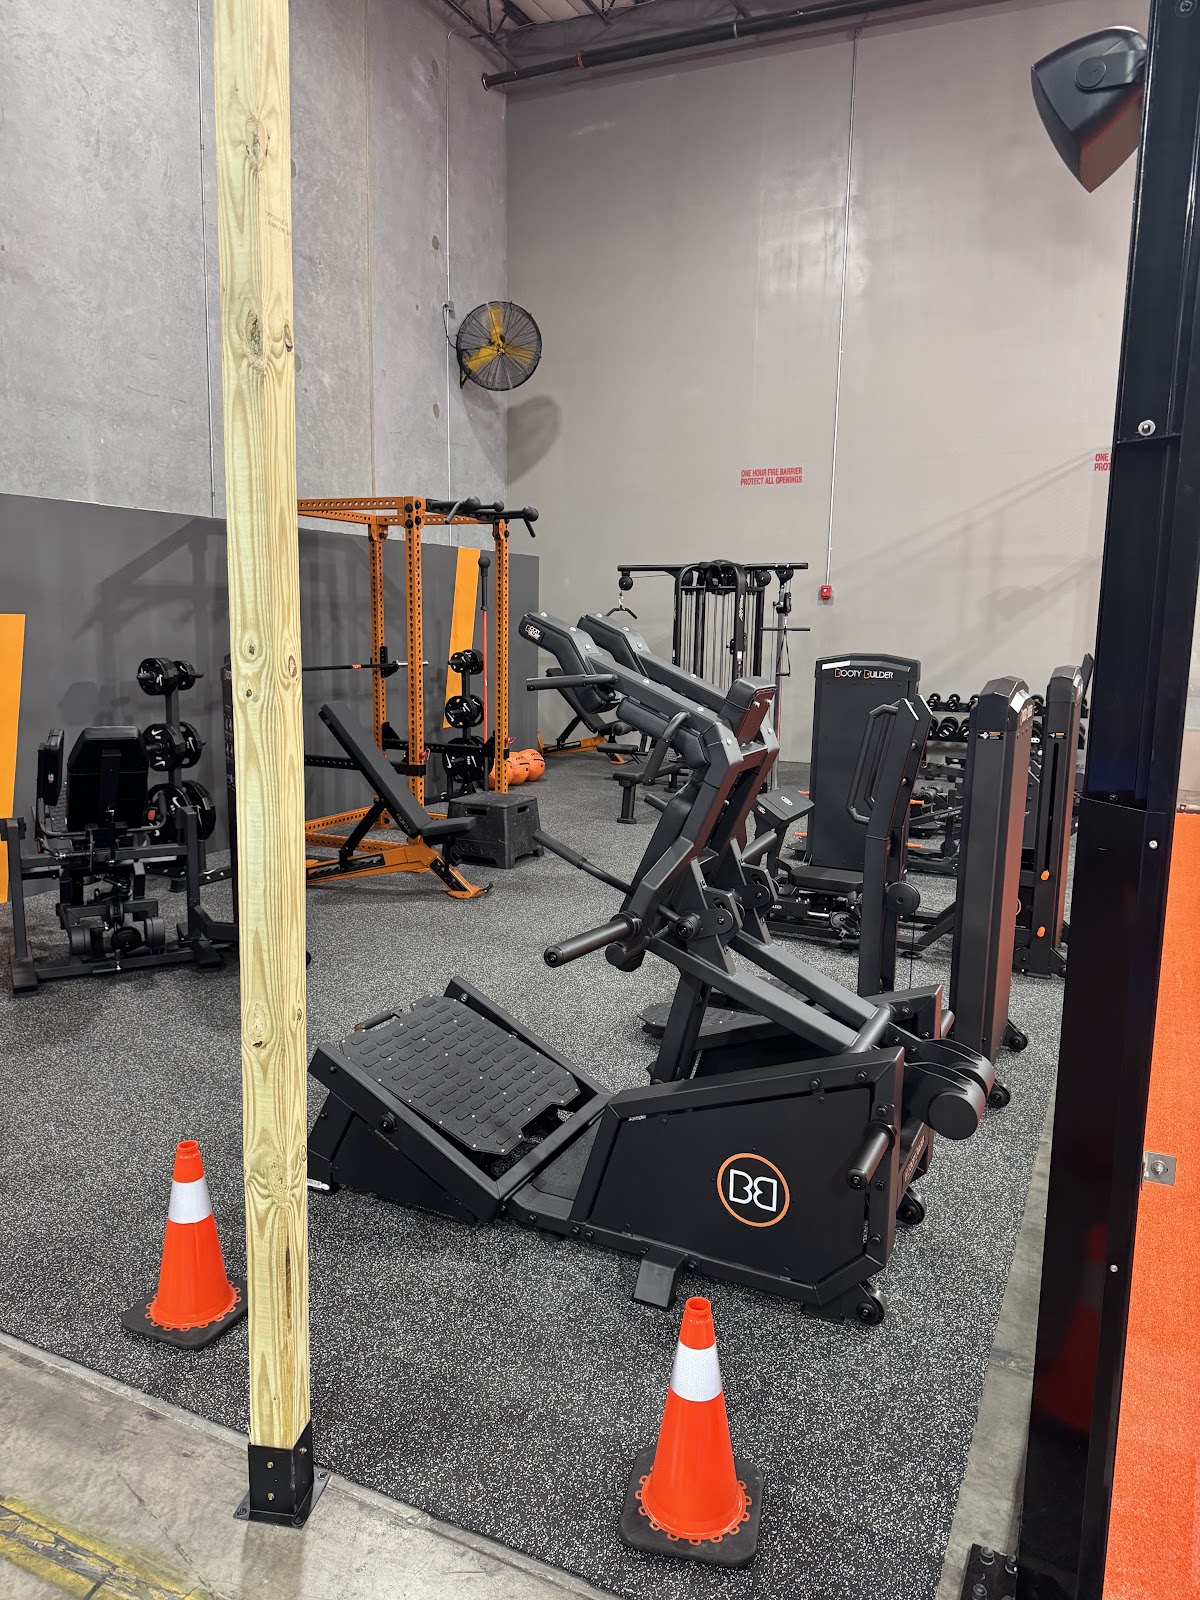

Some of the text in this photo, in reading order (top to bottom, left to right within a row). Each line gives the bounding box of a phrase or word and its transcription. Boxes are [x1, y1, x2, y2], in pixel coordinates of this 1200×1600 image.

[1095, 453, 1109, 462] ONE
[753, 469, 767, 477] HOUR
[768, 468, 779, 476] FIRE
[780, 467, 802, 475] BARRIER
[741, 477, 764, 485] PROTECT
[776, 476, 802, 484] OPENINGS
[834, 668, 893, 679] BOOTY BUILDER
